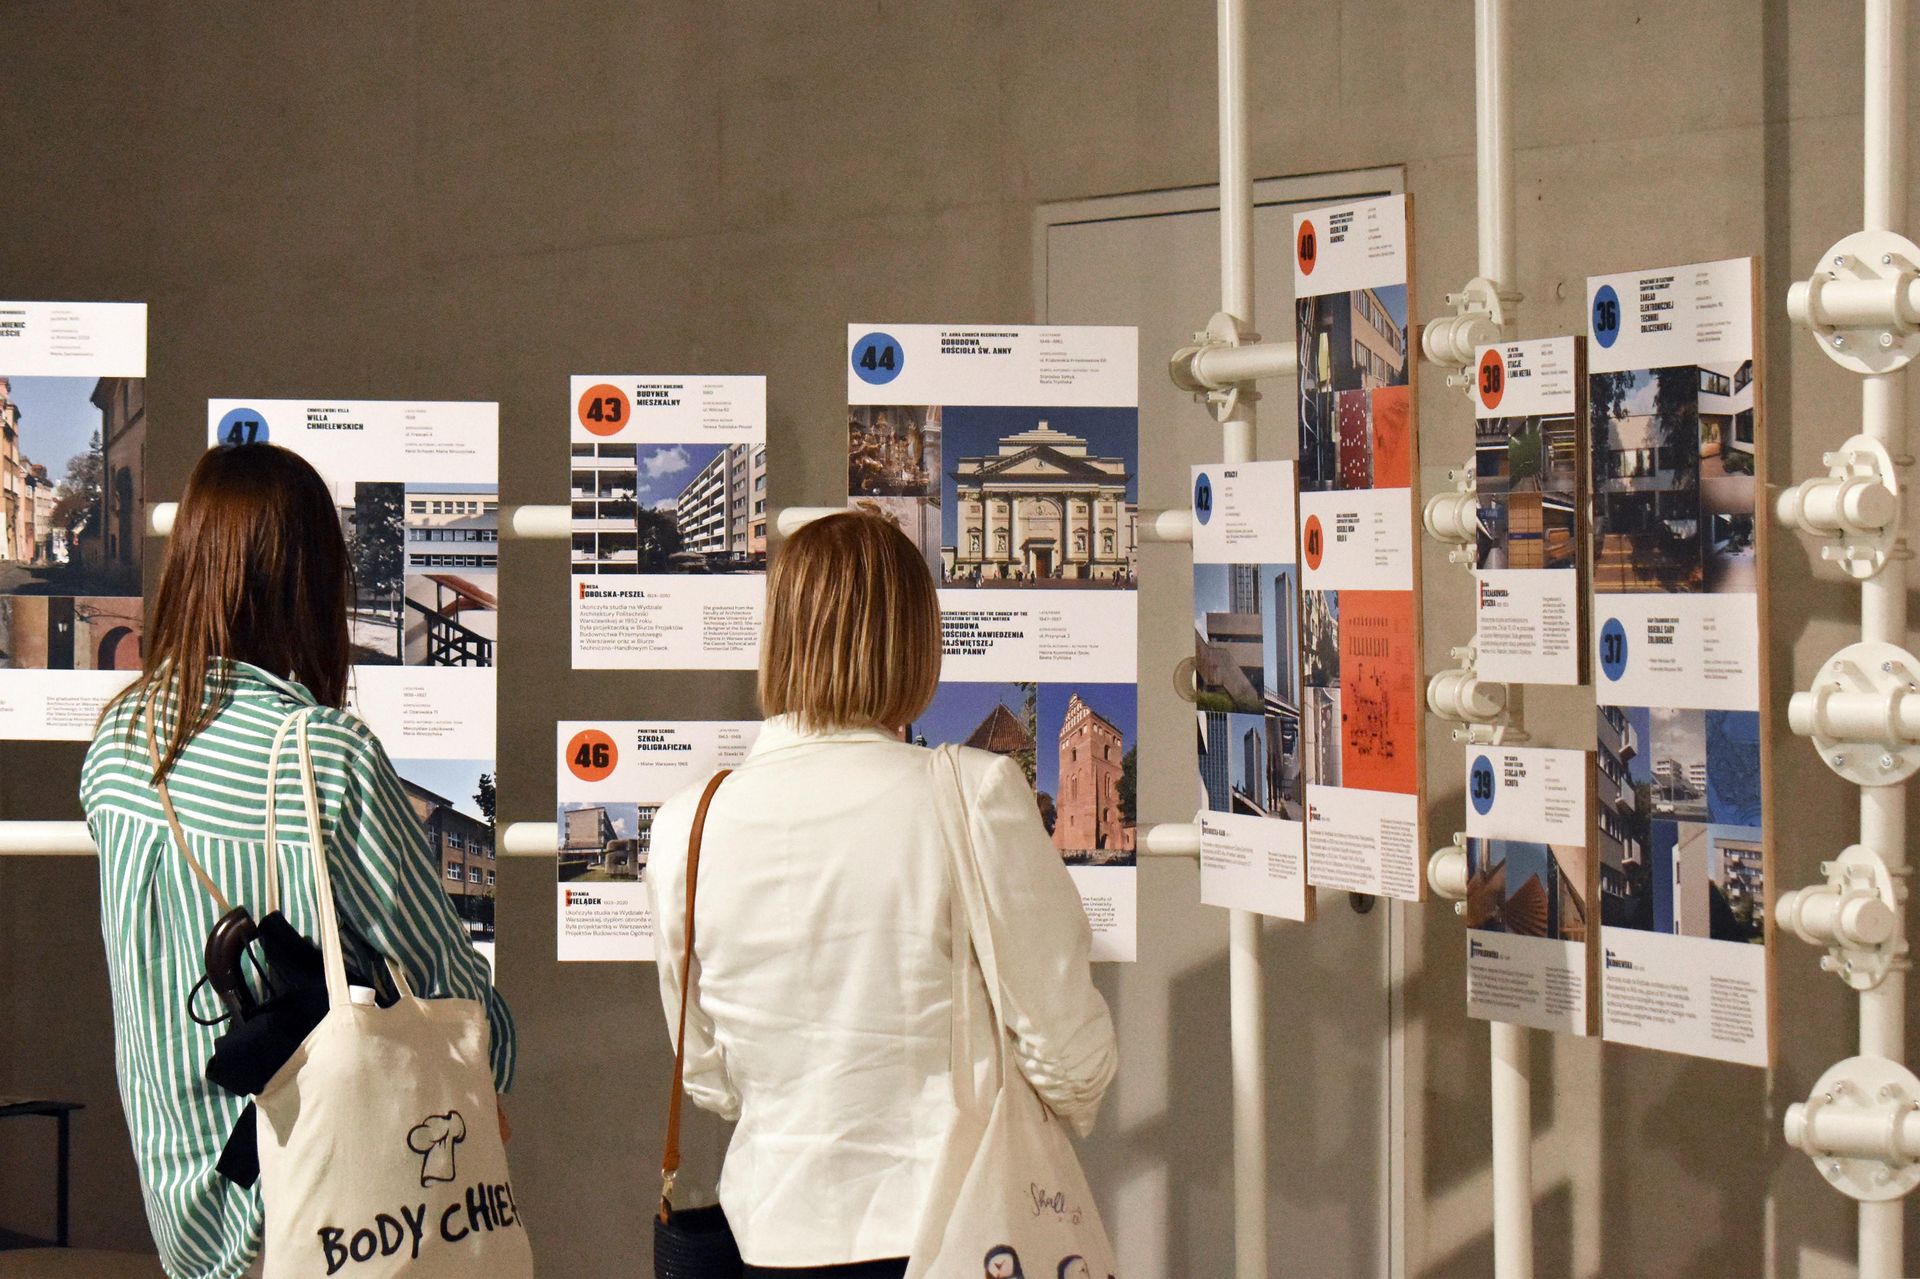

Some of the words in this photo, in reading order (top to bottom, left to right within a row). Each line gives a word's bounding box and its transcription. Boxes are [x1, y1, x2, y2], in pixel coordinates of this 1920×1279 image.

[1300, 234, 1313, 261] 40
[1597, 300, 1616, 331] 36
[860, 346, 895, 370] 44
[1483, 364, 1500, 394] 38
[586, 398, 622, 422] 43
[226, 420, 259, 444] 47
[1198, 486, 1210, 511] 42
[1308, 529, 1319, 556] 41
[1604, 634, 1622, 664] 37
[574, 743, 610, 768] 46
[1474, 770, 1491, 799] 39
[317, 1203, 426, 1276] BODY
